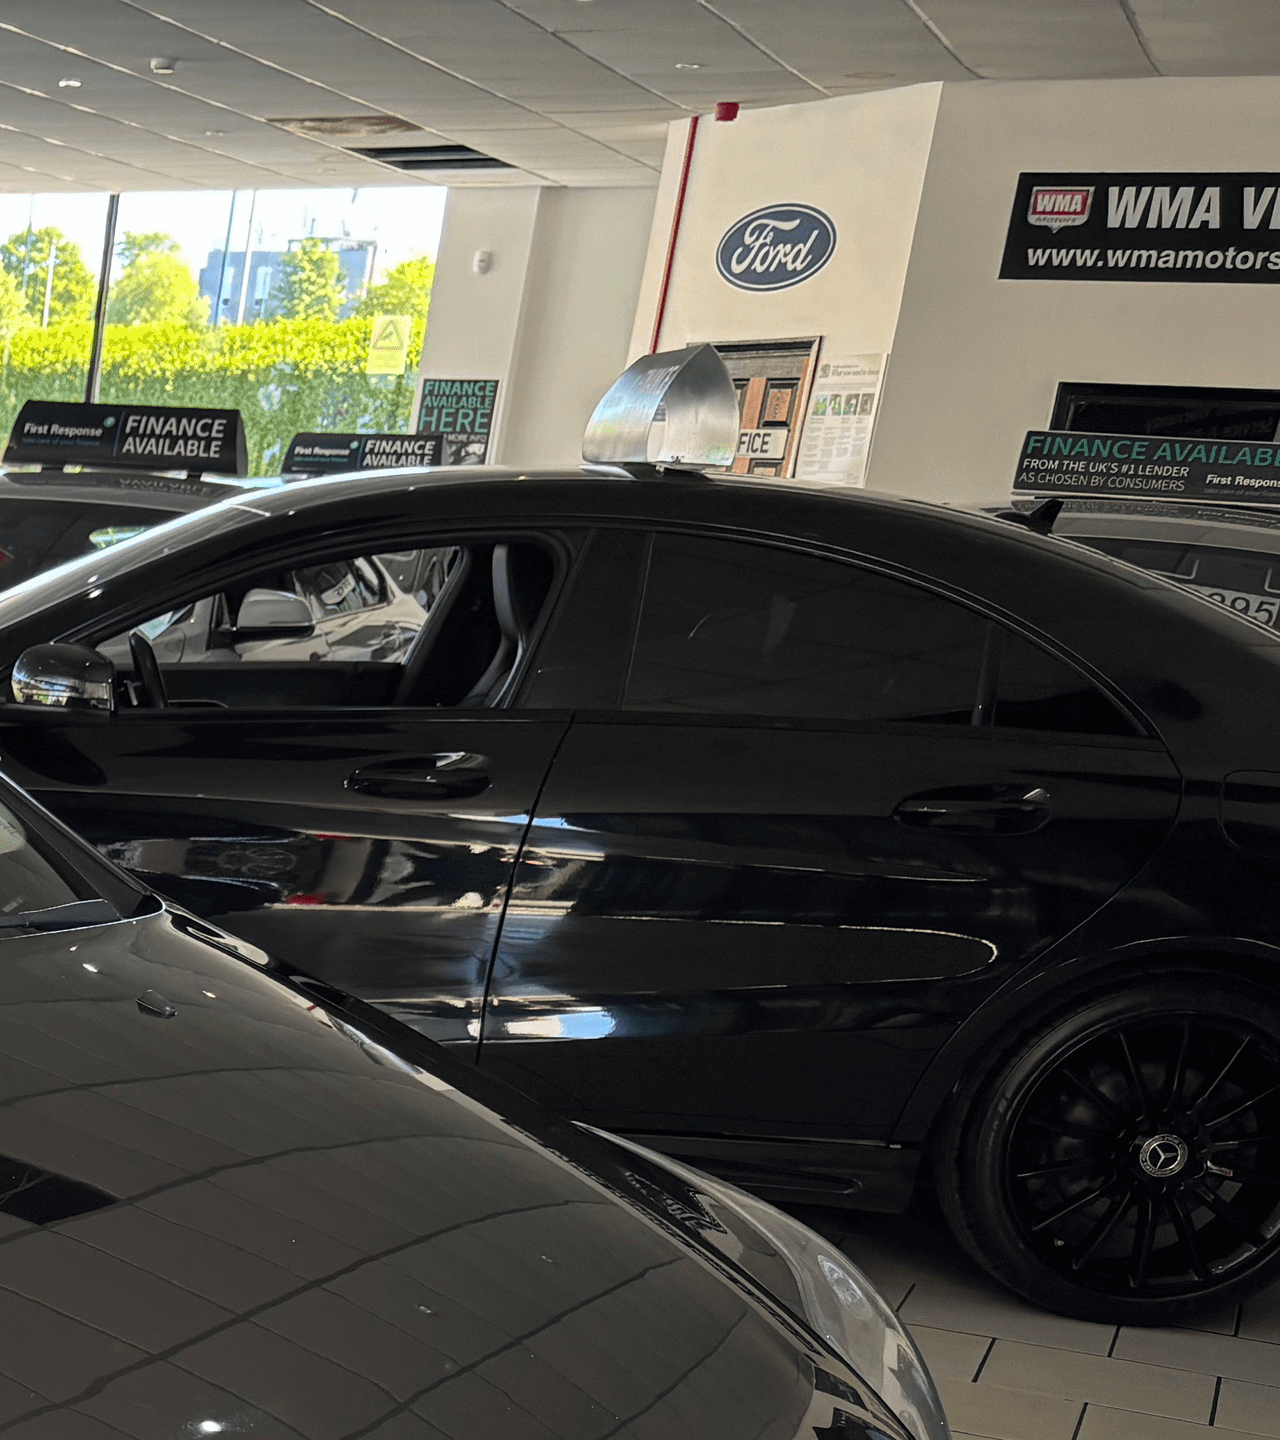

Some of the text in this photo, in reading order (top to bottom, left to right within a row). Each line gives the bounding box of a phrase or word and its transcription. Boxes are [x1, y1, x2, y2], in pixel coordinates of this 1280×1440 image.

[1036, 194, 1083, 212] WMA
[1107, 186, 1220, 229] WMA
[730, 217, 815, 276] Ford
[424, 381, 496, 396] FINANCE
[424, 396, 494, 409] AVAILABLE
[24, 422, 103, 438] First Response
[125, 415, 227, 438] FINANCE
[419, 408, 490, 433] HERE
[122, 437, 222, 458] AVAILABLE
[364, 440, 435, 455] FINANCE
[737, 432, 771, 454] FICE
[1026, 436, 1280, 467] FINANCE AVAILAB
[363, 455, 432, 467] AVAILABLE
[1023, 458, 1190, 477] FROM THE UK'S #1 LENDER
[1019, 472, 1185, 491] AS CHOSEN BY CONSUMERS
[1206, 474, 1280, 488] First Respons
